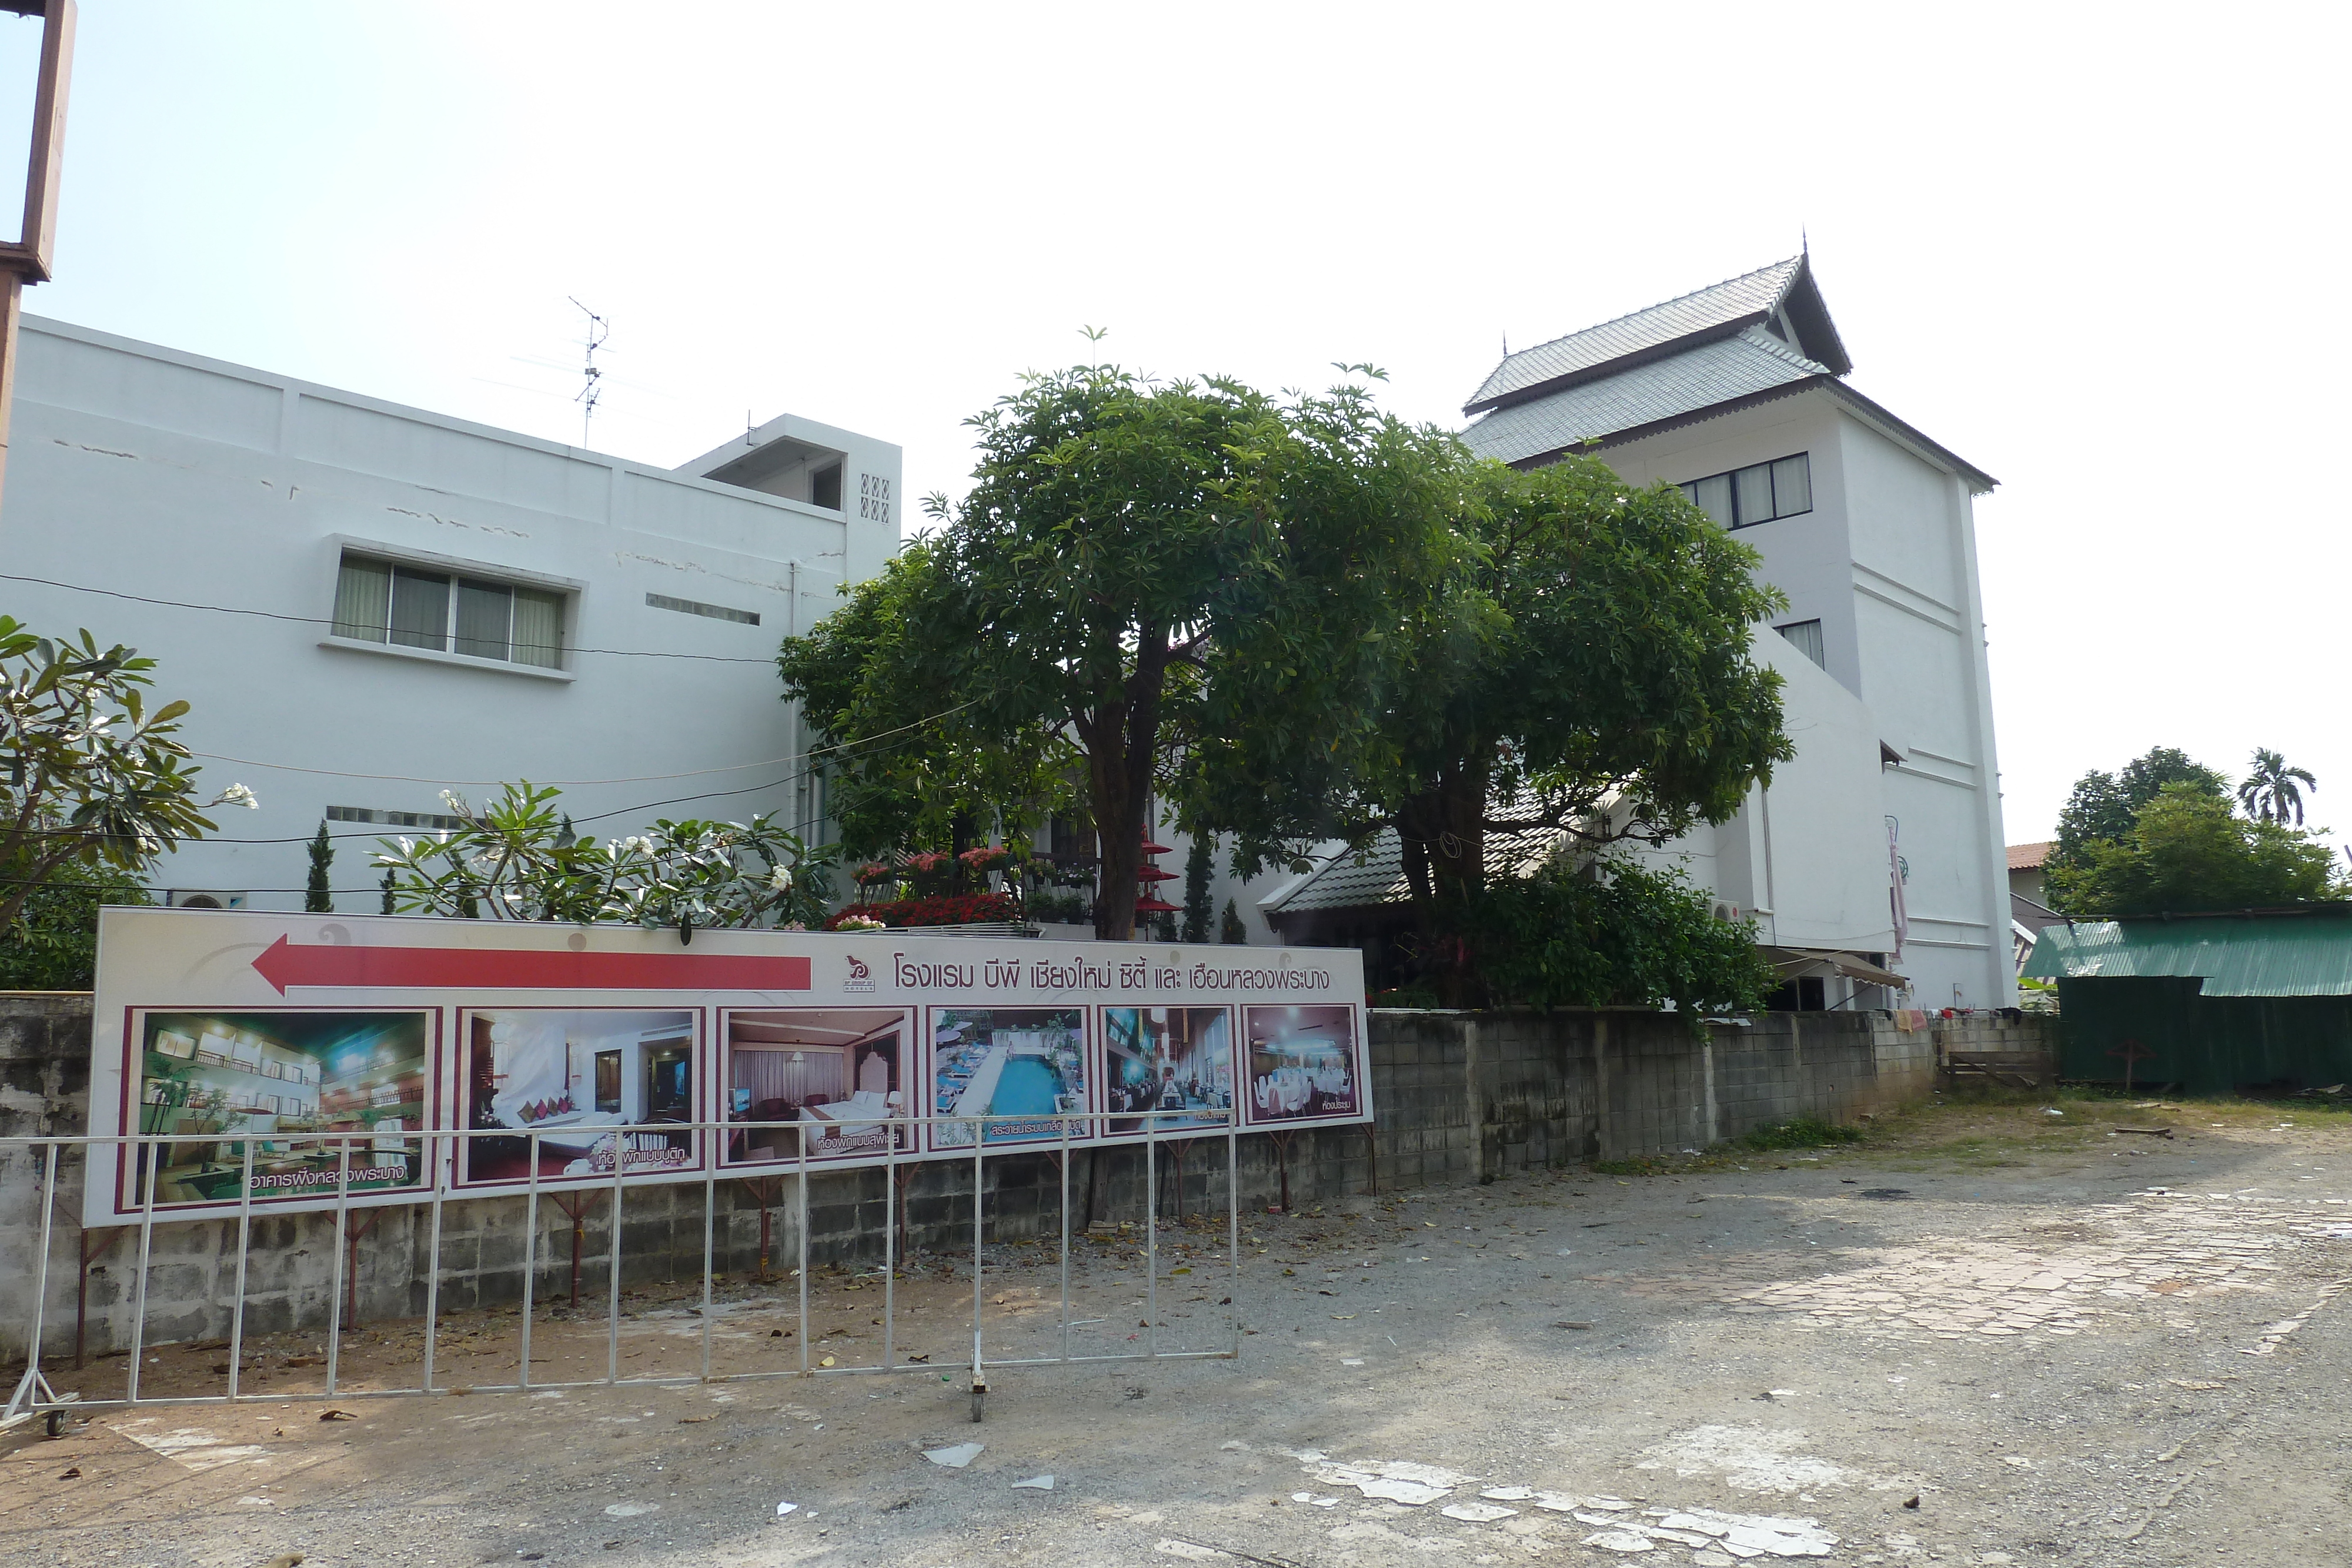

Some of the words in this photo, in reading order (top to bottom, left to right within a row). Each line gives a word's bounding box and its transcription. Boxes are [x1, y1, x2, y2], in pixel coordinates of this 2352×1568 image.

[893, 952, 974, 988] โรงแรม
[984, 958, 1021, 988] บีพี
[1030, 956, 1112, 989] เชียงใหม่
[1118, 956, 1147, 989] ซิตี้
[1155, 968, 1181, 989] และ
[1189, 962, 1330, 989] เฮือนหลวงพระบาง
[817, 1132, 900, 1149] ห้องพักแบบสุพีเย
[598, 1147, 685, 1165] ห้อพักแบบบูติก
